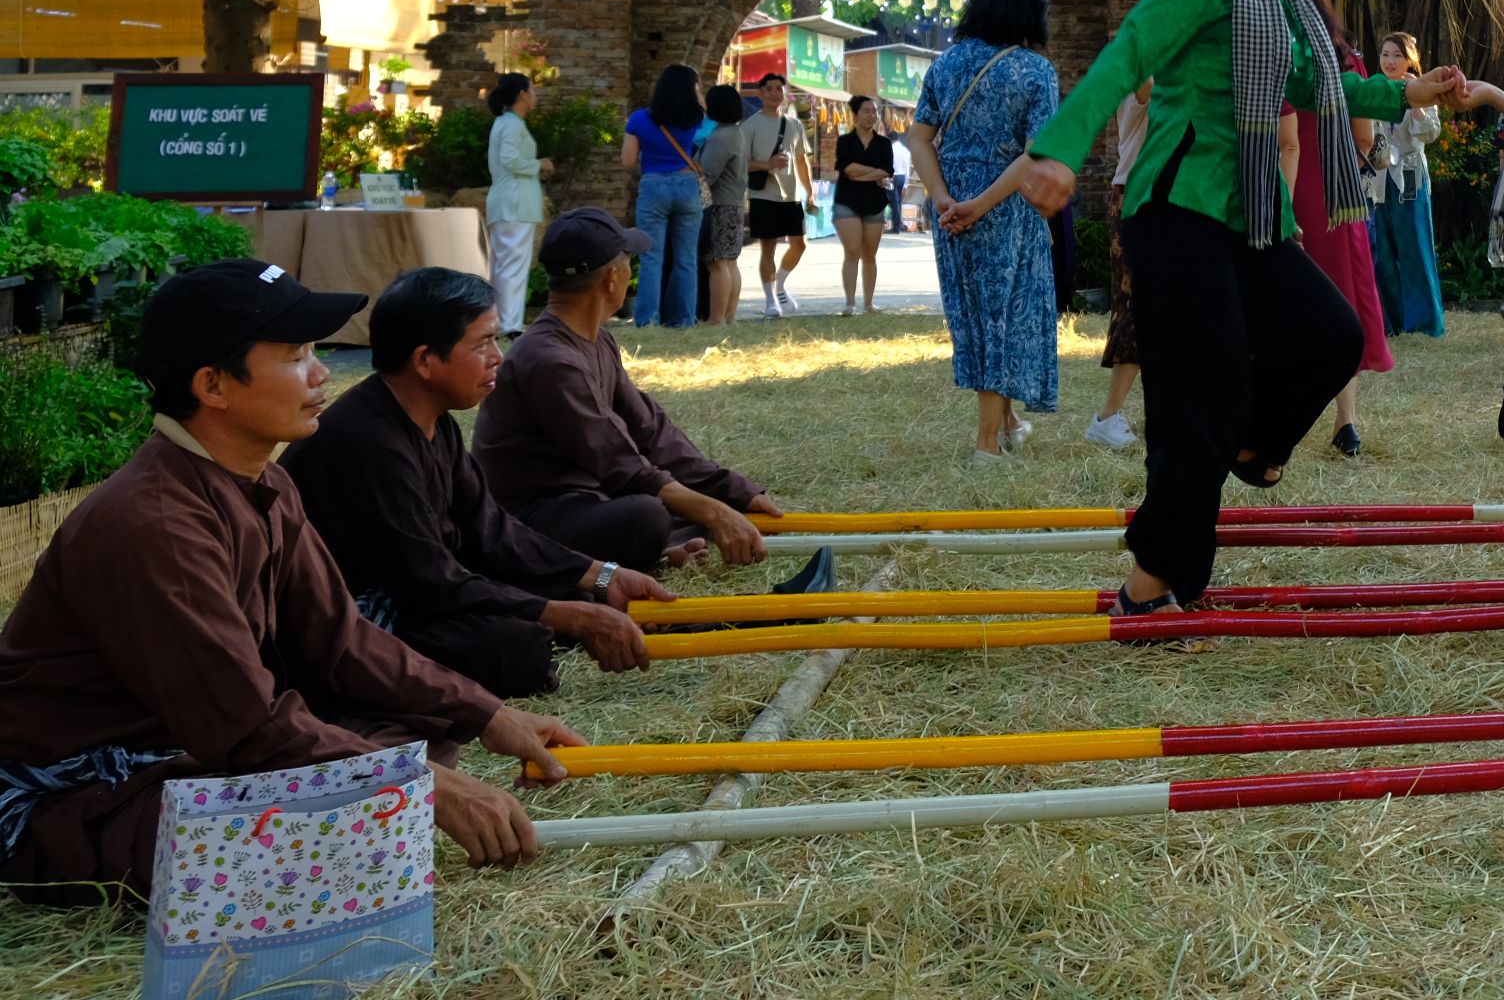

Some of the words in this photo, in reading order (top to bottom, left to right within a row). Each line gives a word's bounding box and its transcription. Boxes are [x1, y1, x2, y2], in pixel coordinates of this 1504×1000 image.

[149, 108, 178, 123] KHU
[181, 107, 209, 126] VỰC
[211, 104, 246, 123] SOÁT
[249, 103, 269, 122] VÉ
[160, 132, 205, 156] (CỔNG
[205, 132, 228, 156] SỐ
[258, 264, 286, 283] PUM
